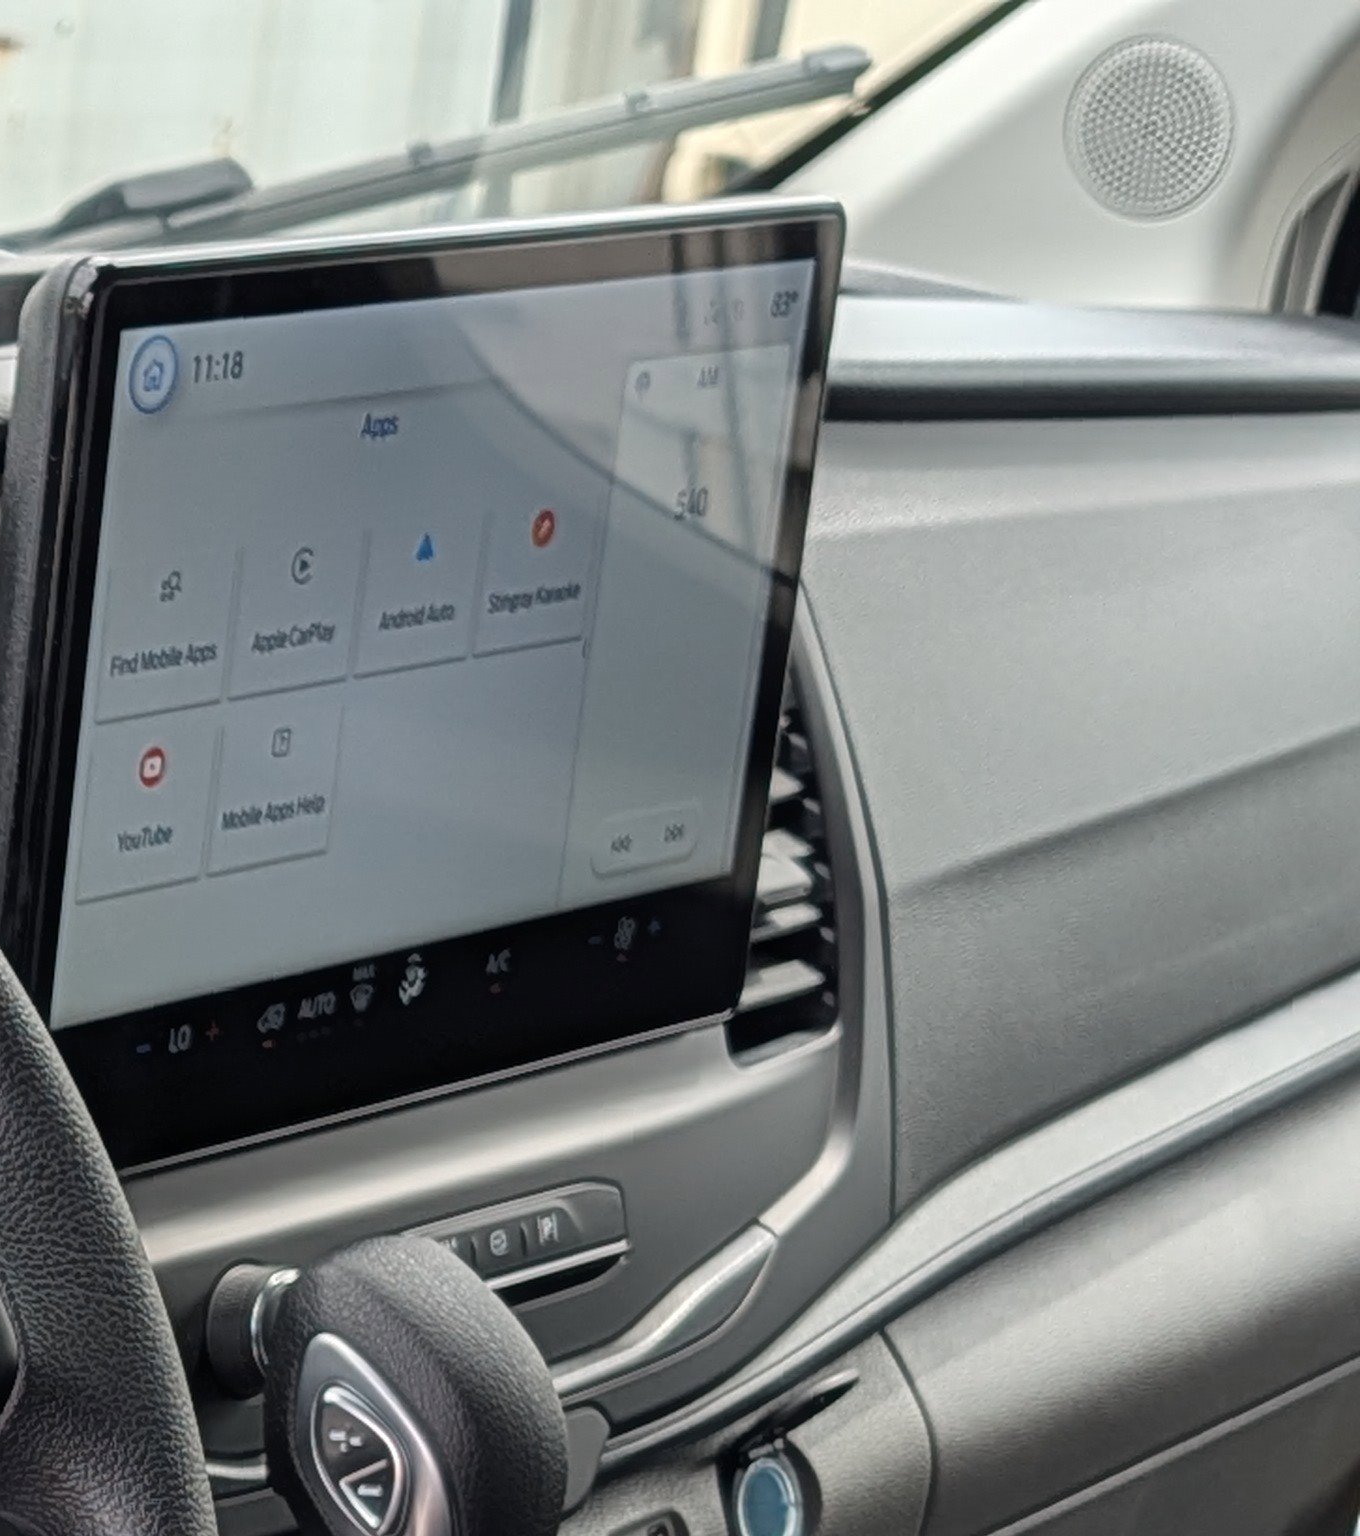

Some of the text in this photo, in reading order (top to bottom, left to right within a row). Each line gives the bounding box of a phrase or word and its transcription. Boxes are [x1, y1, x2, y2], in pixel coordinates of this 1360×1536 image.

[194, 351, 244, 383] 11:18
[361, 413, 399, 440] Apps
[379, 602, 455, 630] Android Auto
[252, 621, 335, 654] Apple CarPlay
[109, 643, 218, 678] Find Mobile Apps
[221, 793, 326, 831] Mobile Apps Help
[117, 823, 174, 852] YouTube
[297, 990, 337, 1019] AUTO
